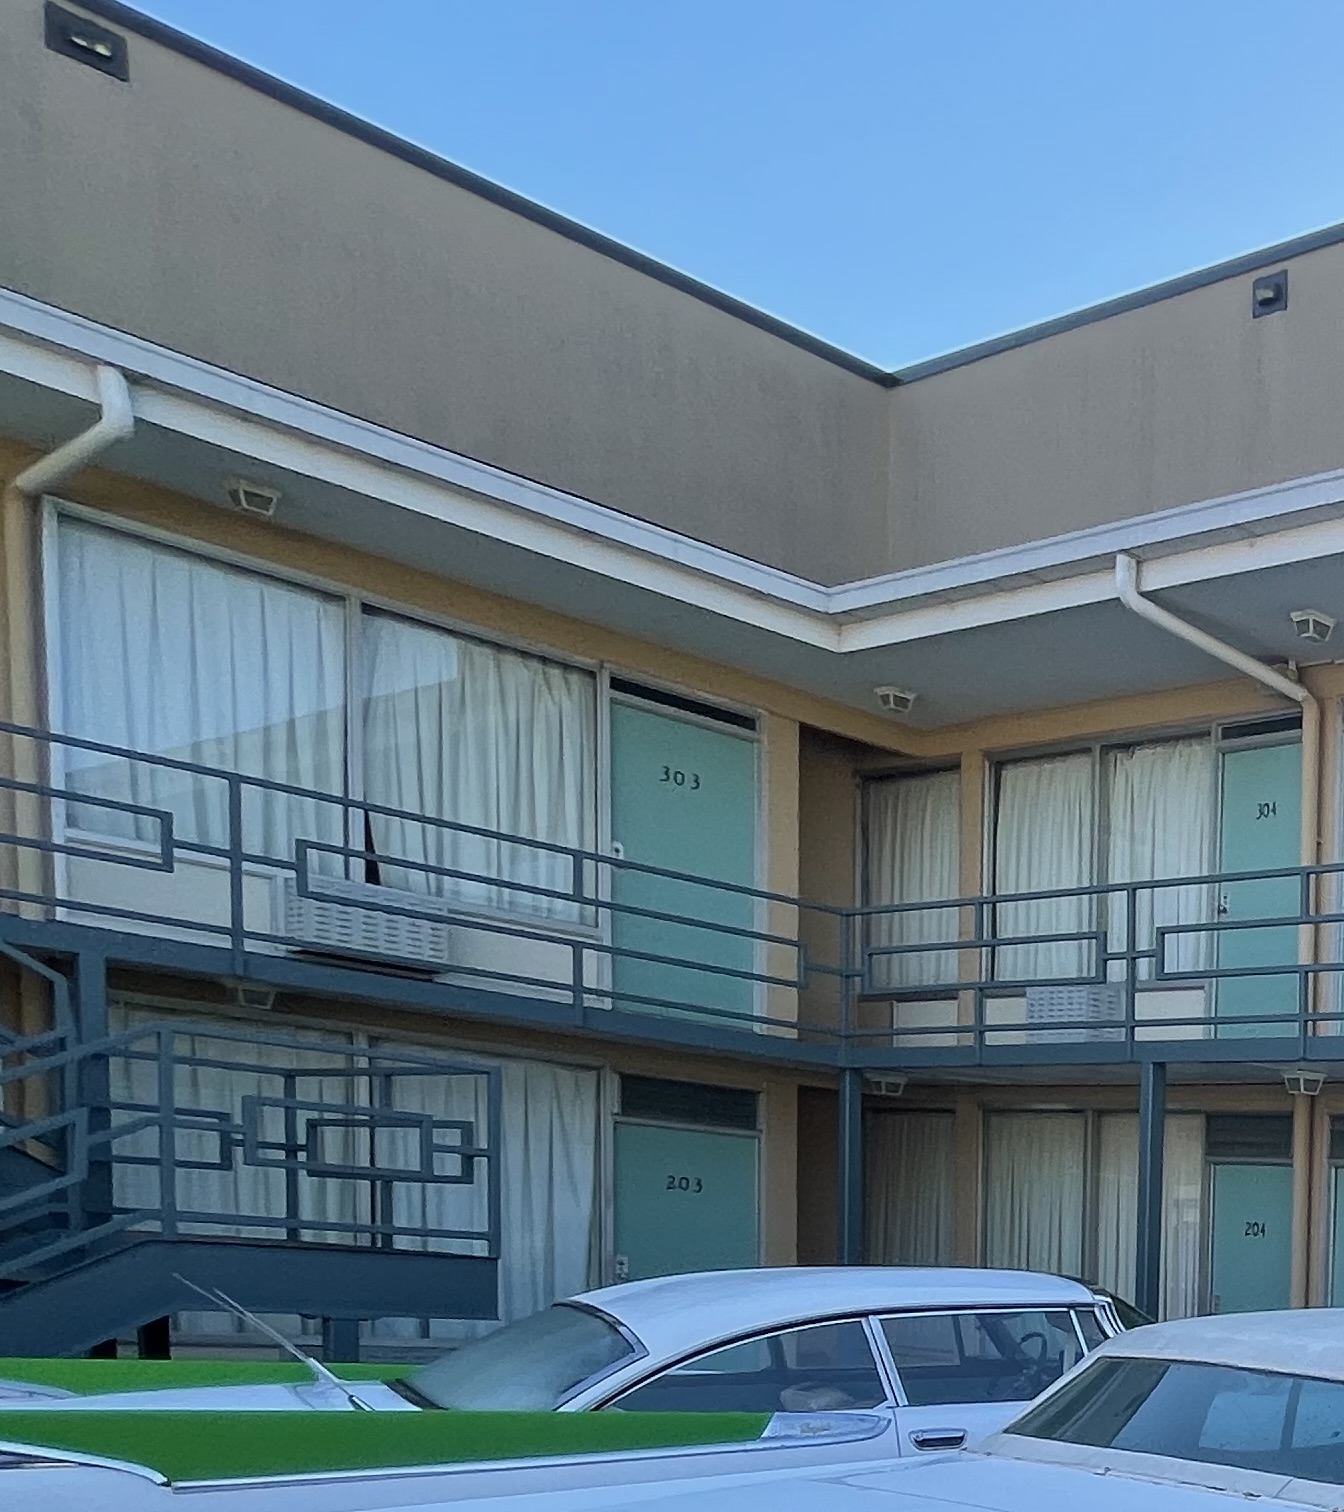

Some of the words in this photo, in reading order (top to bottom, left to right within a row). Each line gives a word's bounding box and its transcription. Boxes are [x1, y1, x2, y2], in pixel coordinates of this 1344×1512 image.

[659, 765, 701, 790] 303
[1256, 802, 1277, 820] 304
[666, 1175, 703, 1193] 203
[1244, 1221, 1266, 1238] 204
